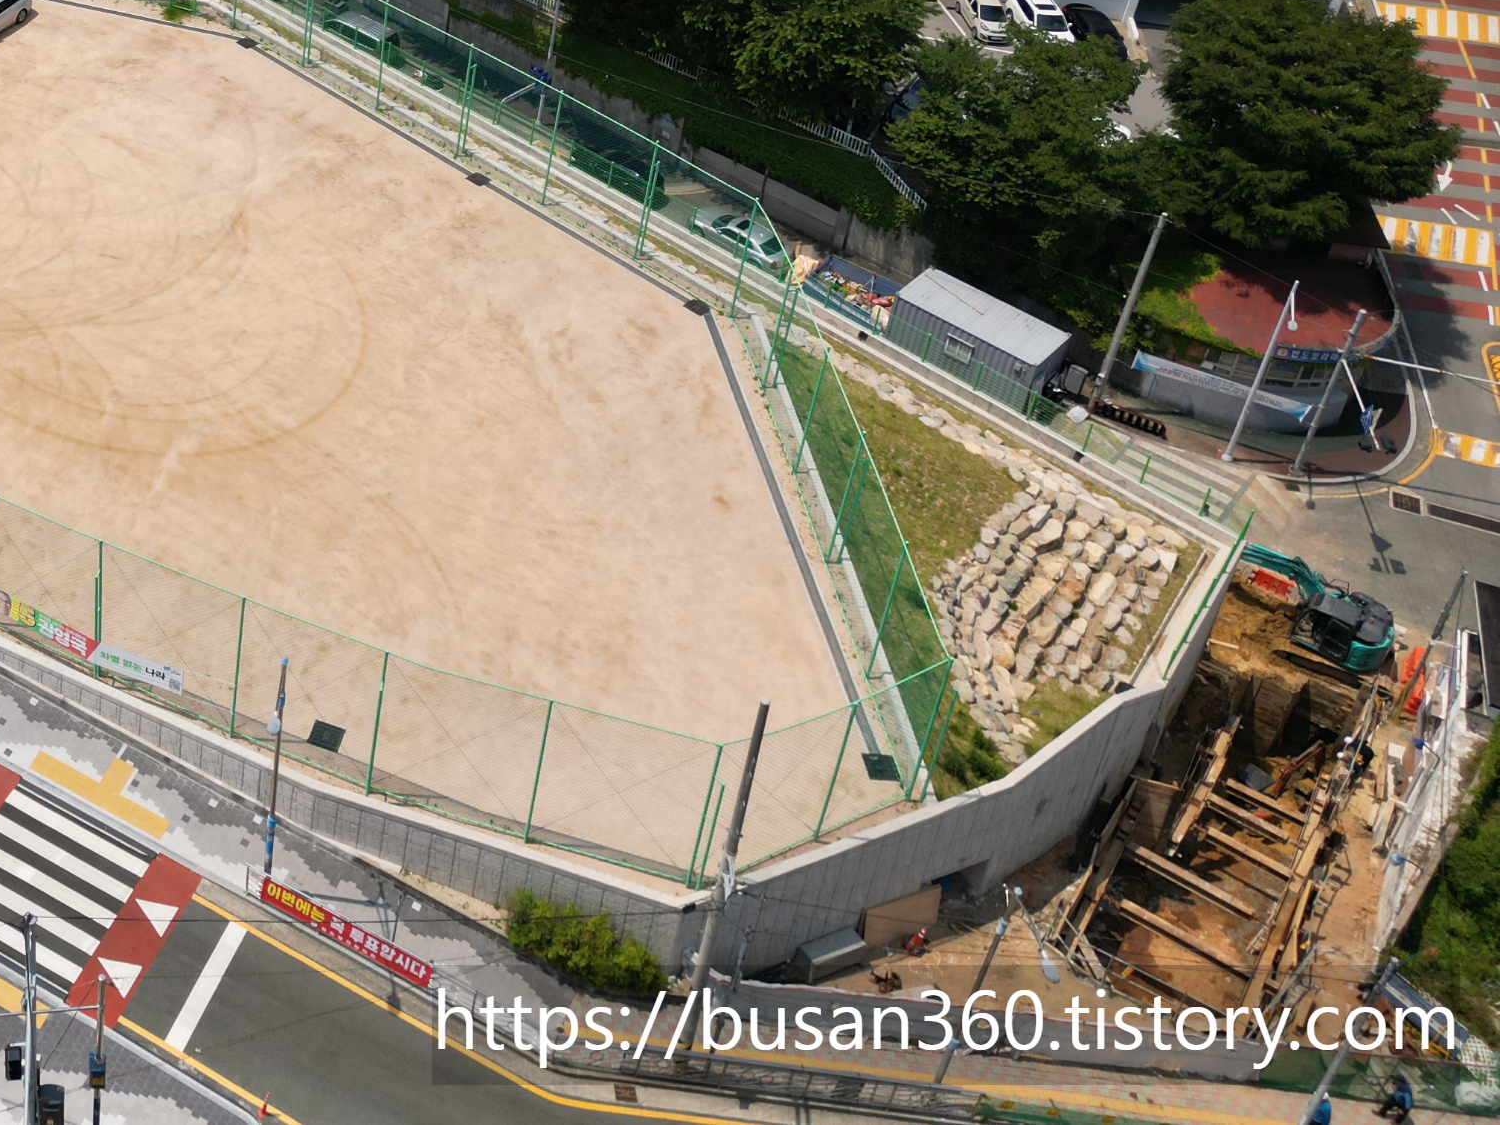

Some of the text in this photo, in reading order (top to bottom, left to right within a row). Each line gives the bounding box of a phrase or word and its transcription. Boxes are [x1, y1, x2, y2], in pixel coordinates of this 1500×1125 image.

[145, 667, 166, 681] 나라
[267, 883, 325, 923] 이번에는
[350, 928, 427, 979] 투표합시다
